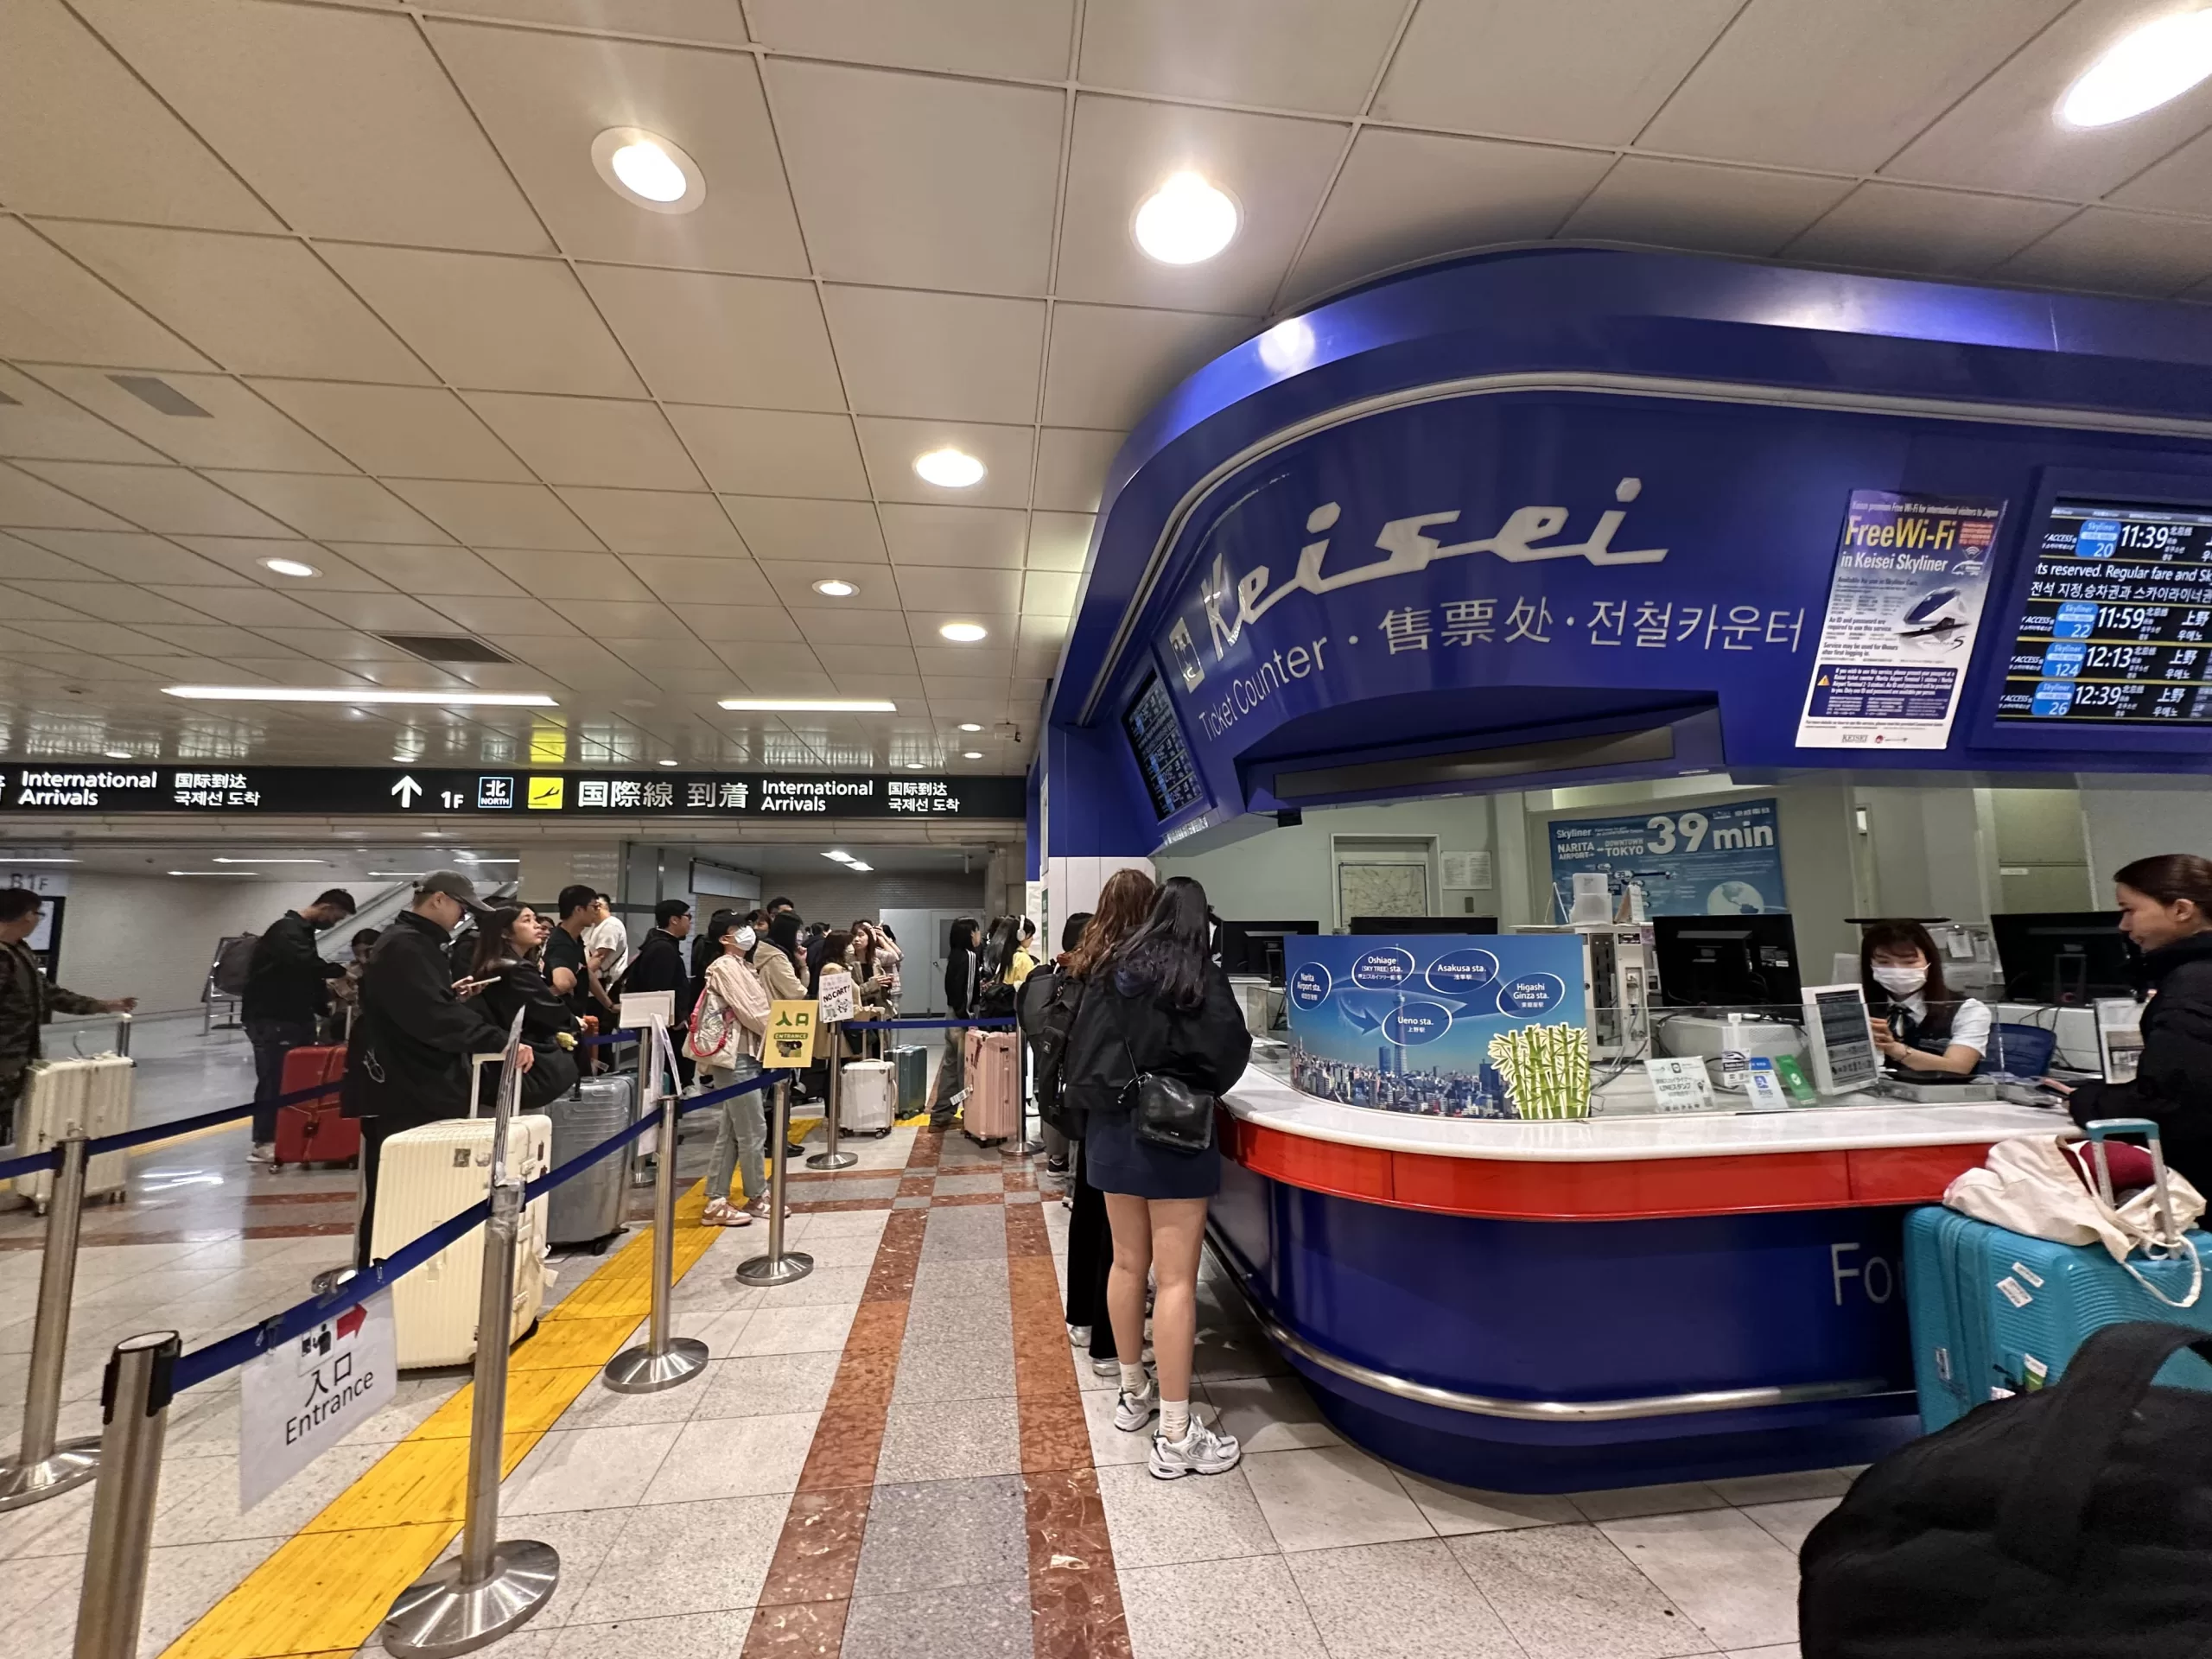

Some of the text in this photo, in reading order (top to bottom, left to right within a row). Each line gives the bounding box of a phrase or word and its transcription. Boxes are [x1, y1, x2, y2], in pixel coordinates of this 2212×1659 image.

[2121, 524, 2169, 549] 11:39
[2093, 543, 2113, 557] 20
[1200, 477, 1669, 663] Keisei
[1840, 551, 1948, 574] in Keisei Skyliner
[2050, 563, 2102, 577] reserved.
[2105, 564, 2150, 582] Regular
[2151, 566, 2173, 581] fare
[2174, 568, 2197, 582] and
[2197, 569, 2212, 586] Sk
[1586, 600, 1805, 652] 전철카운터
[2098, 607, 2145, 629] 11:59
[2181, 610, 2210, 626] 上野
[2070, 623, 2091, 638] 22
[2087, 646, 2133, 668] 12:13
[2169, 649, 2198, 665] 上野
[2055, 664, 2080, 677] 124
[1198, 637, 1327, 741] Ticket Counter
[2075, 685, 2122, 705] 12:39
[2157, 688, 2186, 702] 上野
[2049, 702, 2069, 715] 26
[22, 770, 157, 789] International
[175, 772, 247, 789] 国际到达
[486, 779, 506, 797] 北
[578, 781, 748, 808] 国際線 到着
[762, 779, 874, 797] International
[888, 781, 948, 797] 国际到达
[18, 788, 99, 806] Arrivals
[174, 791, 260, 807] 국제선 도착
[441, 791, 464, 809] 1F
[480, 797, 510, 806] NORTH
[760, 795, 826, 812] Arrivals
[888, 798, 961, 812] 국제선 도착
[1556, 829, 1592, 839] Skyliner
[1647, 812, 1774, 855] 39 min
[1557, 842, 1594, 854] NARITA
[1605, 838, 1643, 848] DOWNTOWN
[1558, 852, 1590, 861] AIRPORT
[1606, 846, 1644, 857] TOKYO
[11, 873, 48, 890] B1F
[1368, 957, 1396, 966] Oshiage
[1437, 963, 1470, 972] Asakusa
[1300, 973, 1315, 982] Narita
[1297, 981, 1322, 992] Airport sta.
[1516, 982, 1545, 993] Higashi
[823, 994, 832, 1002] NO
[1513, 991, 1535, 1000] Ginza
[1397, 1016, 1419, 1025] Ueno
[1831, 1243, 1904, 1306] Fo
[305, 1352, 352, 1408] 入口
[286, 1371, 374, 1446] Entrance
